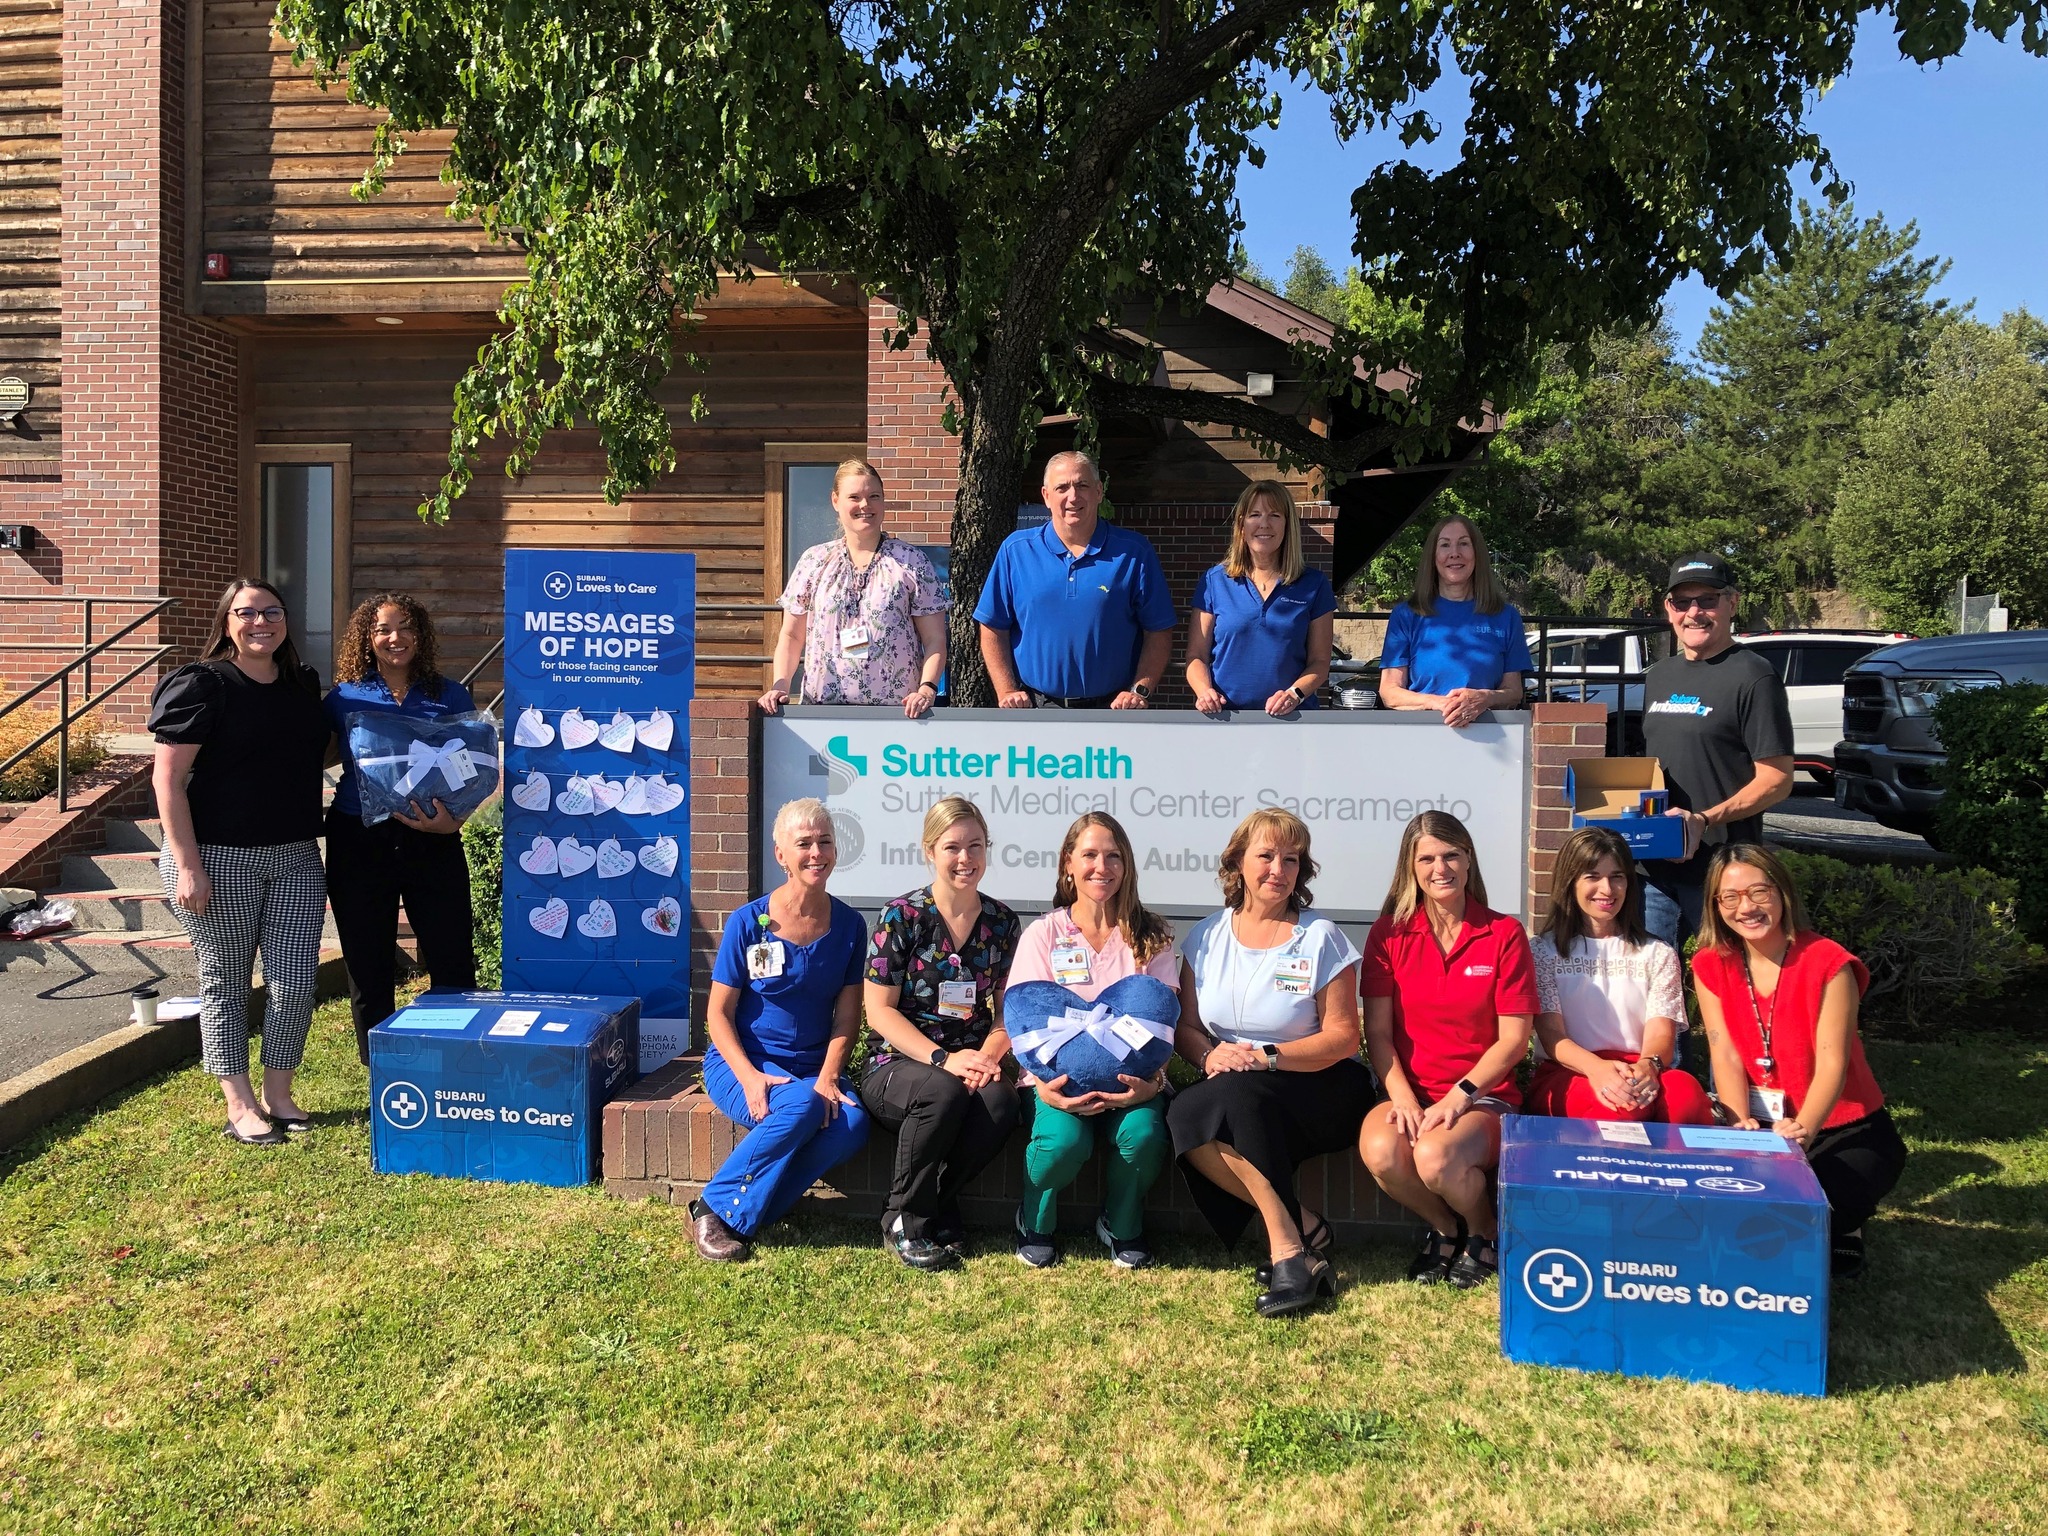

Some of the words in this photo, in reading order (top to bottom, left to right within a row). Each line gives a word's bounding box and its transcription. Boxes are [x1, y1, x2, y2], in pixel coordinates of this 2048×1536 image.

[576, 582, 611, 593] Loves
[614, 582, 626, 593] to
[628, 583, 657, 594] Care
[524, 611, 675, 634] MESSAGES
[1476, 626, 1506, 638] SUBRU
[539, 636, 576, 656] OF
[584, 638, 659, 659] HOPE
[541, 660, 556, 670] for
[558, 661, 586, 670] those
[589, 662, 620, 672] facing
[623, 663, 658, 672] cancer
[552, 674, 562, 682] in
[564, 675, 582, 683] our
[584, 674, 643, 685] community.
[1670, 694, 1700, 704] Subaru
[1648, 700, 1714, 716] Ambassador
[882, 744, 1001, 778] Sutter
[1008, 746, 1132, 779] Health
[882, 783, 980, 813] Suttr
[991, 785, 1116, 816] Medical
[1130, 786, 1244, 818] Center
[1257, 788, 1472, 822] Sacramento
[834, 854, 866, 872] OMMUNITY
[1143, 848, 1220, 872] Aubu
[1284, 984, 1298, 992] RN
[640, 1034, 669, 1042] KEMIA
[671, 1034, 677, 1042] &
[640, 1042, 676, 1050] PHOMA
[640, 1050, 667, 1058] CIETY
[434, 1090, 486, 1102] SUBARU
[434, 1102, 496, 1121] Loves
[500, 1106, 521, 1123] to
[524, 1110, 574, 1128] Care
[1576, 1155, 1734, 1172] #SubaruLovesToCare
[1552, 1170, 1688, 1188] SUBARU
[1603, 1260, 1678, 1278] SUBARU
[1603, 1276, 1691, 1304] Loves
[1698, 1284, 1729, 1308] to
[1734, 1286, 1811, 1314] Care
